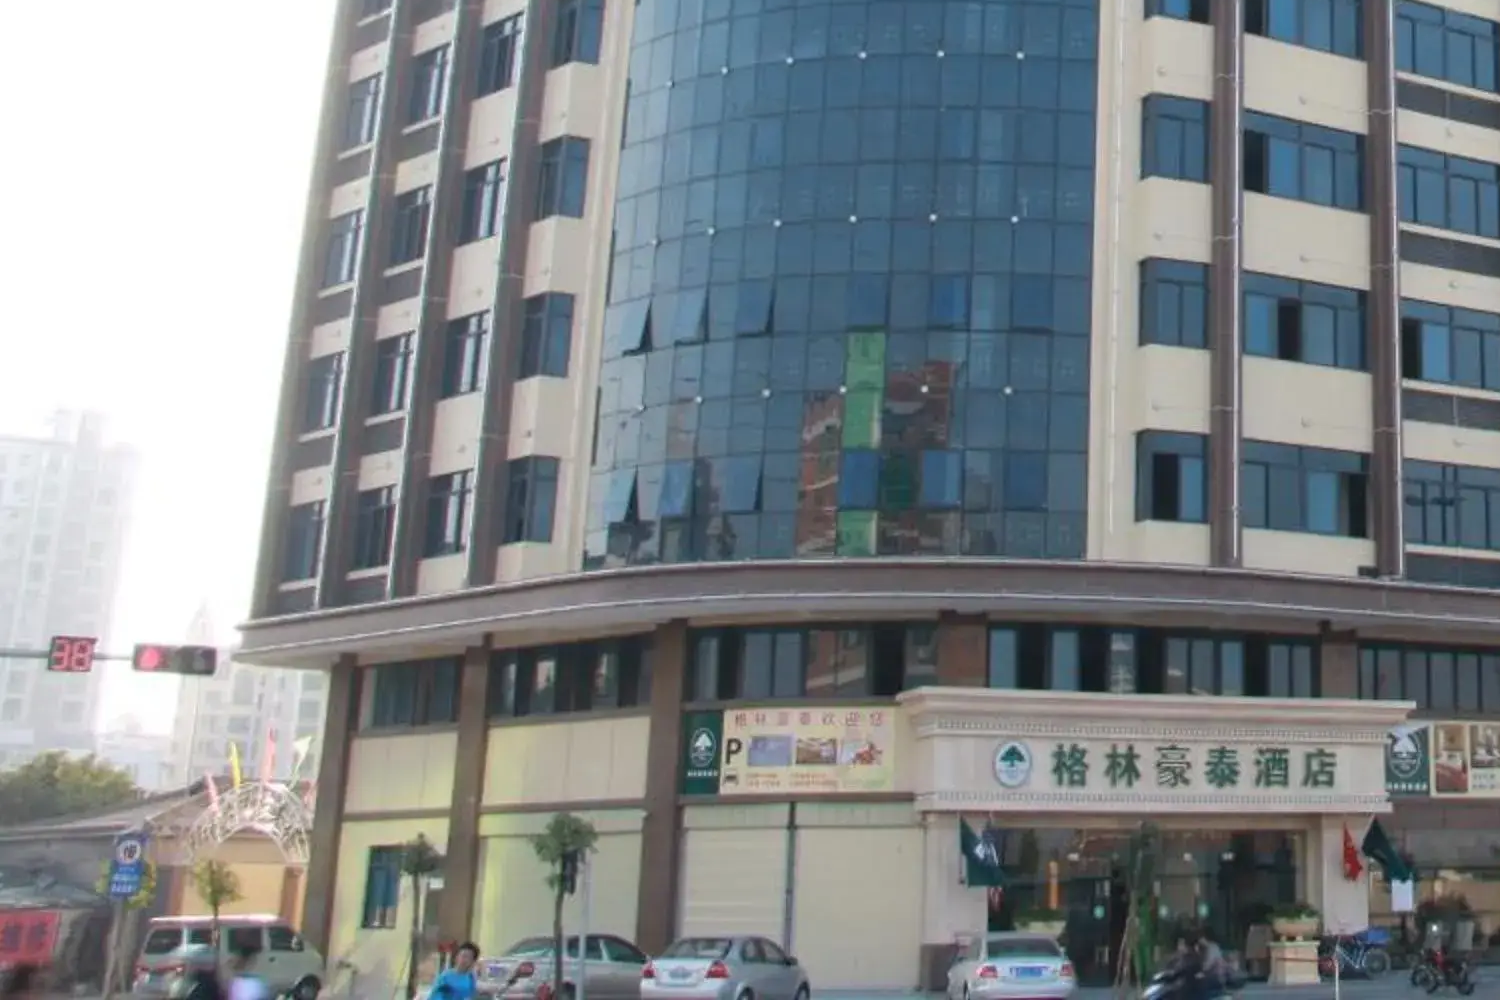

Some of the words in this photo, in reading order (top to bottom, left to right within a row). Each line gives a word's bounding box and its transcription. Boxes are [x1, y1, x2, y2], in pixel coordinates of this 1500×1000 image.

[52, 638, 91, 671] 38
[725, 738, 742, 765] P
[1051, 743, 1337, 789] 格林豪泰酒店
